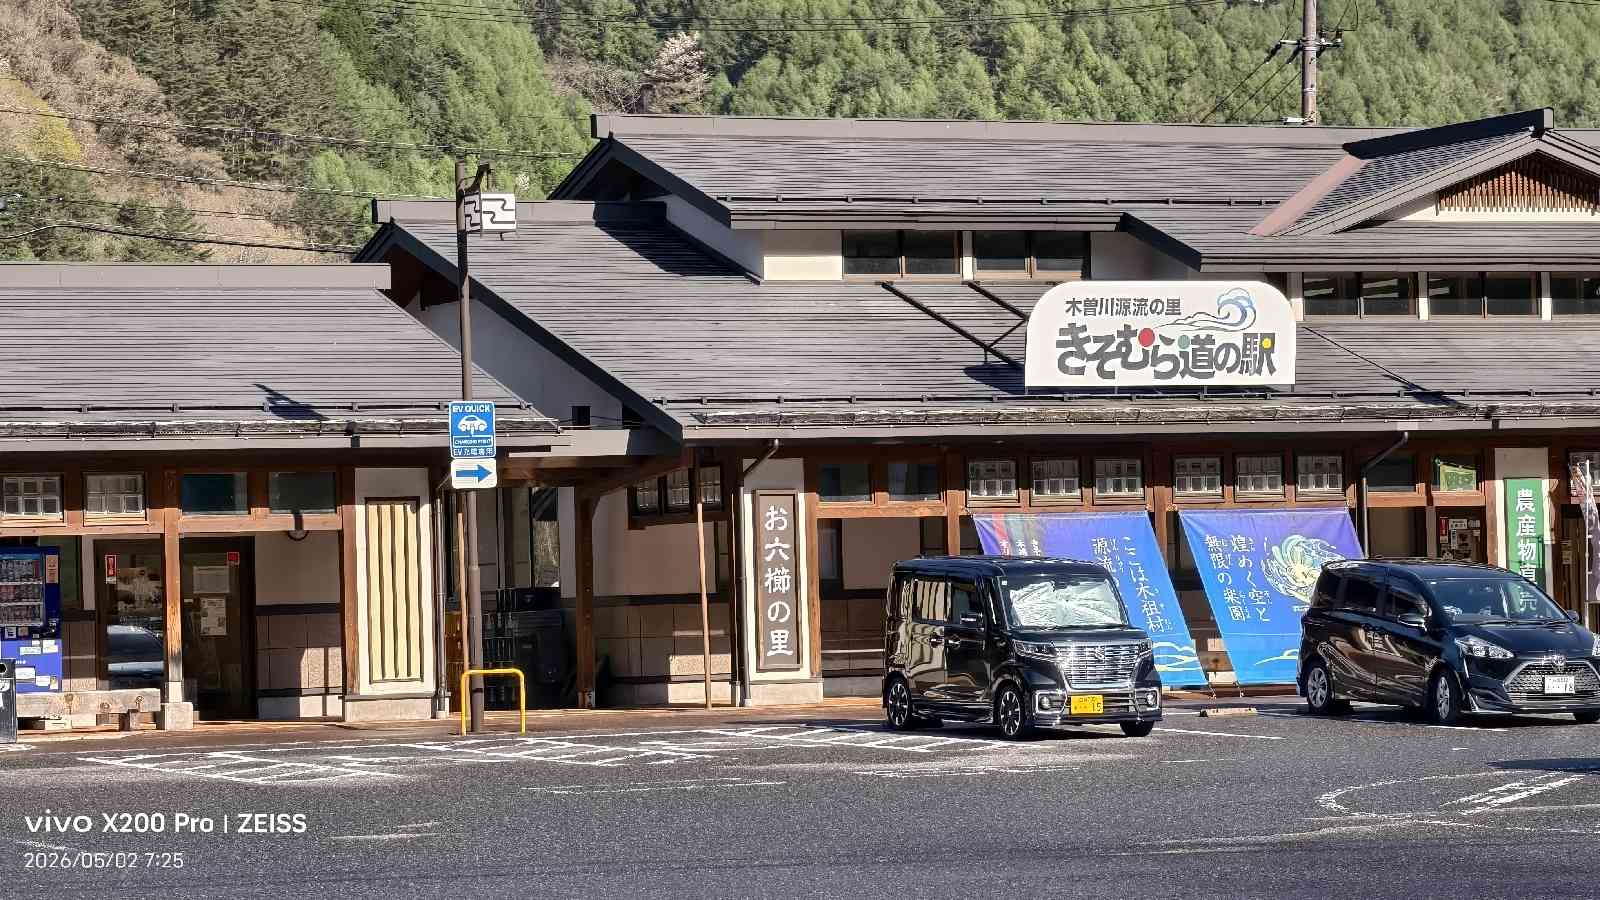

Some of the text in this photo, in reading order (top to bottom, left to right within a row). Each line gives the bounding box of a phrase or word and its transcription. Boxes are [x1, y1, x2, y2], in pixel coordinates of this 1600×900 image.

[1065, 297, 1182, 317] 木曽川源流の里
[1056, 322, 1277, 380] きそむら道の駅
[465, 405, 490, 413] QUICK
[764, 505, 793, 657] お六櫛の里
